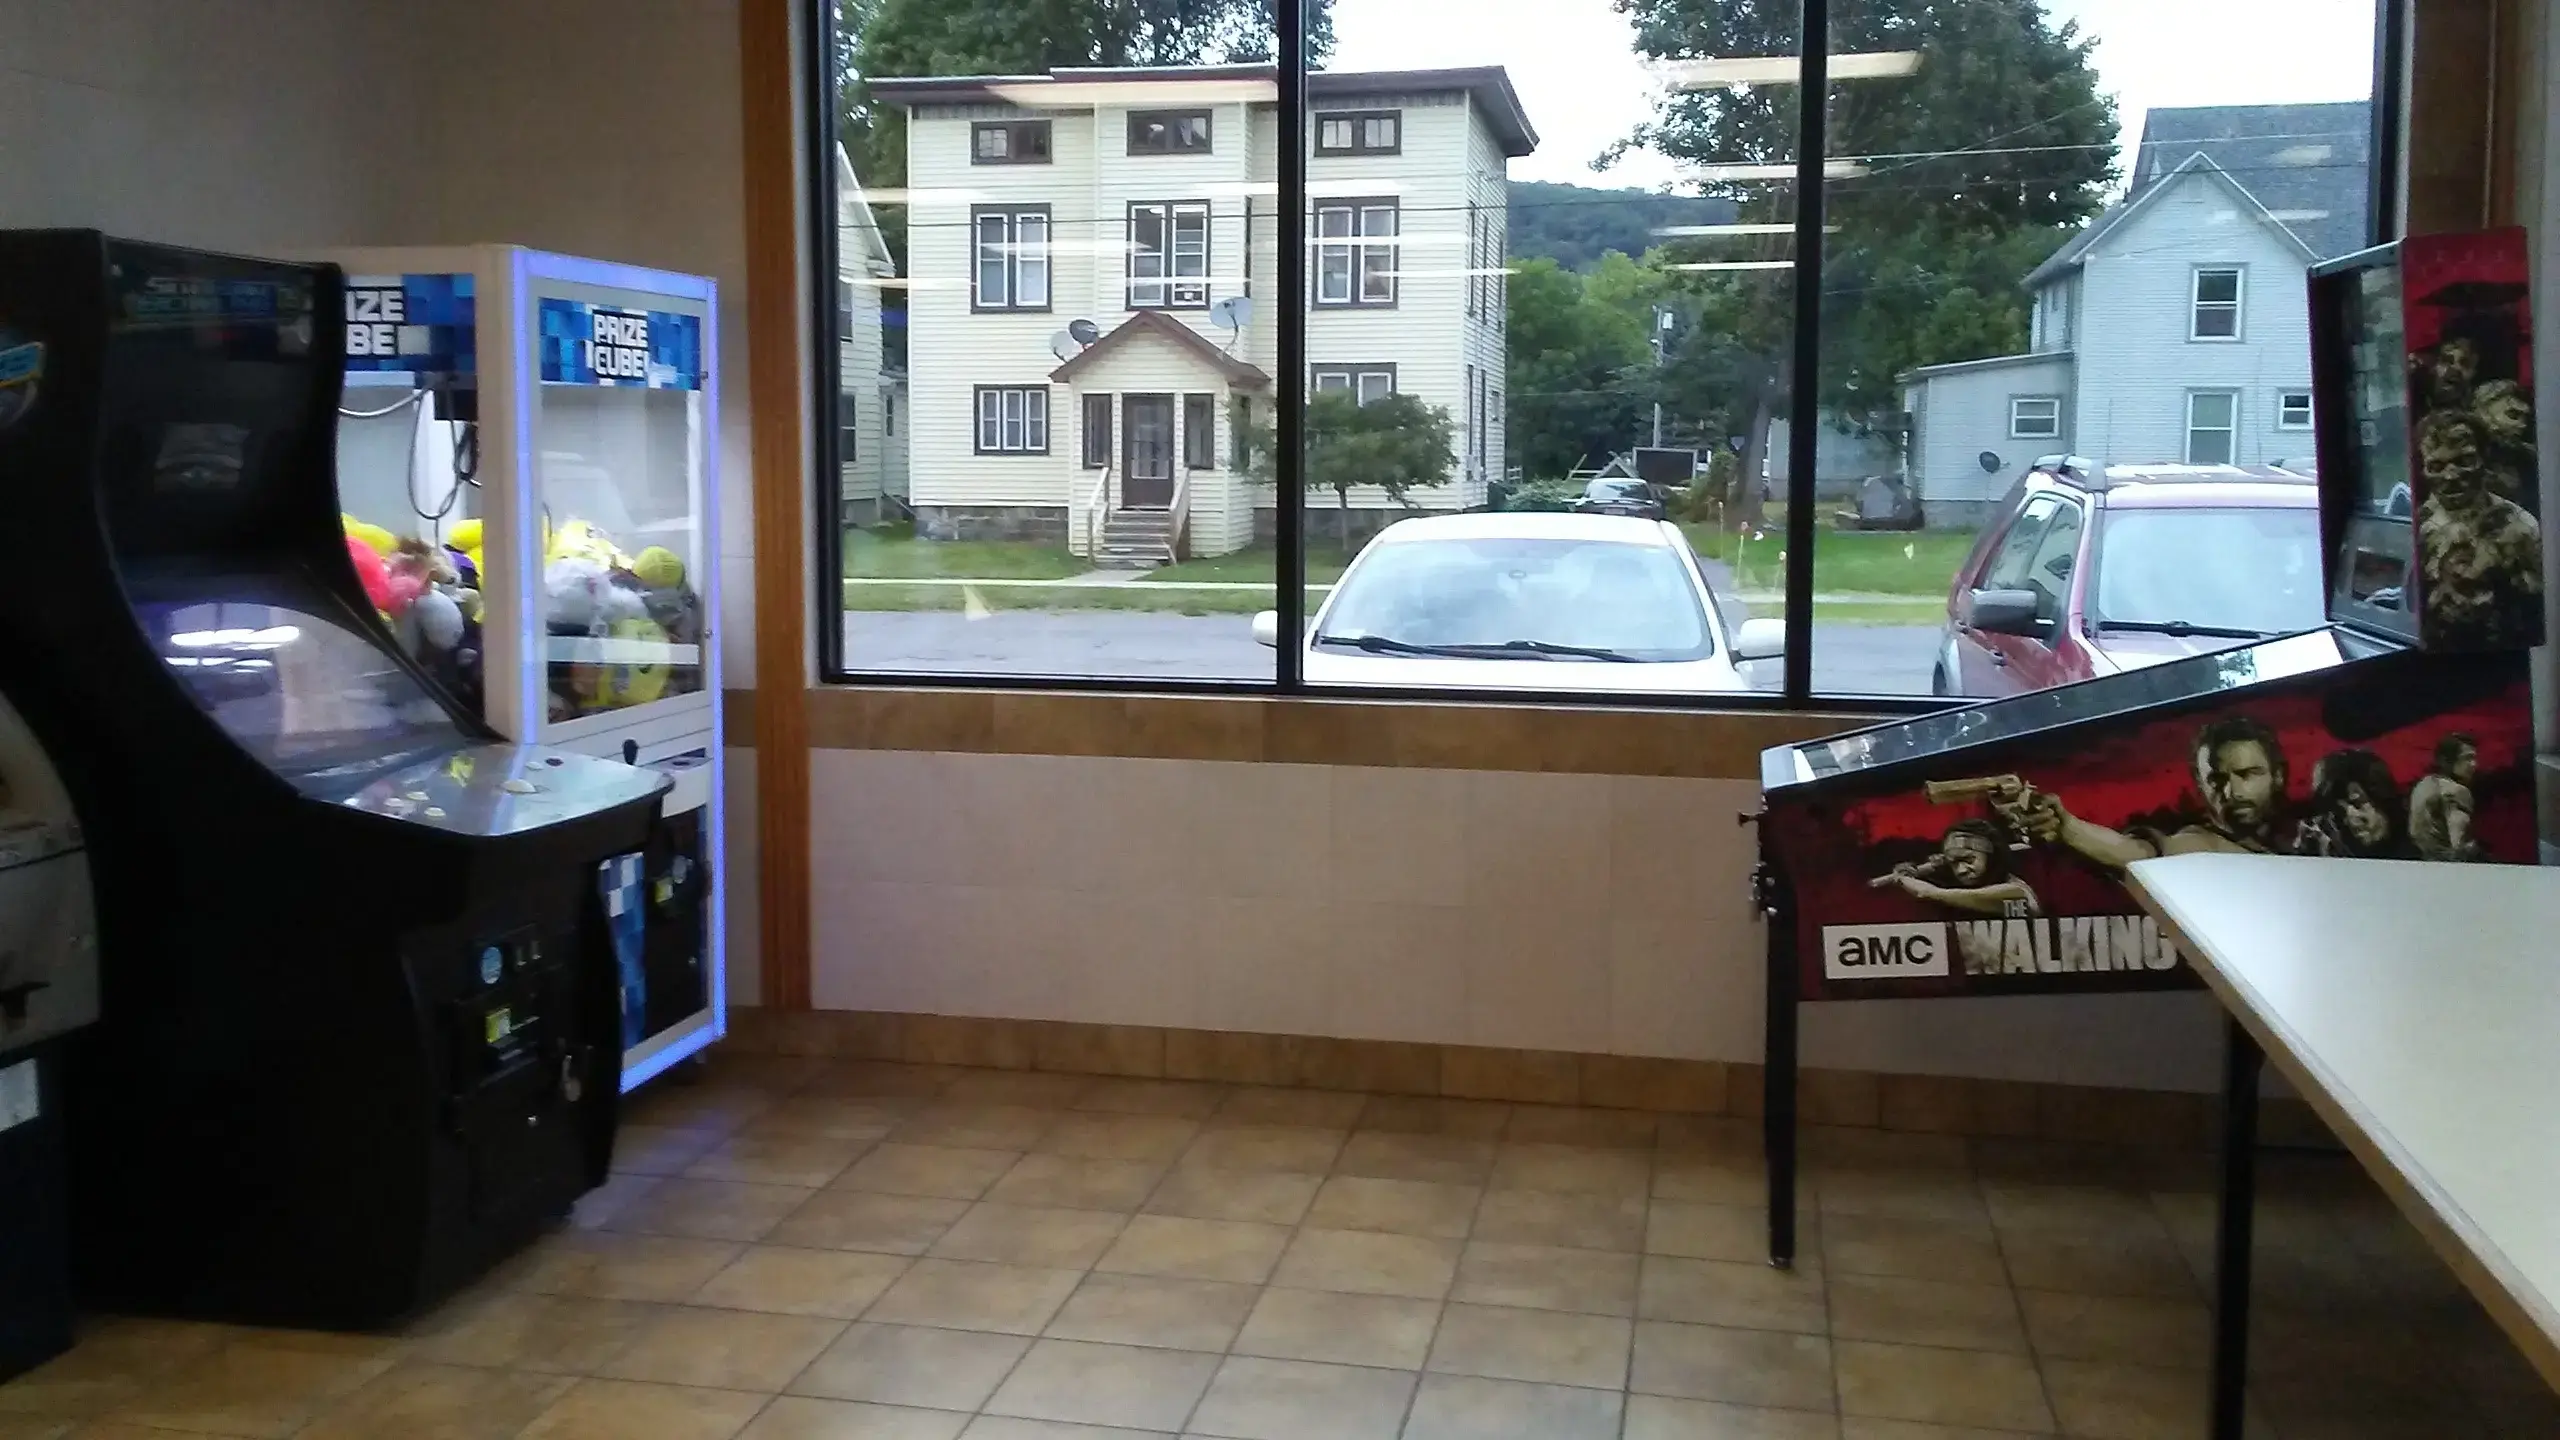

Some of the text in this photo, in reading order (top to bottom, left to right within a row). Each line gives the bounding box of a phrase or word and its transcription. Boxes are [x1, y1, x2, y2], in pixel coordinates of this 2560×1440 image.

[345, 290, 405, 322] IZE
[345, 323, 396, 356] BE
[593, 313, 649, 348] PRIZE
[594, 345, 645, 379] CUBE
[2003, 899, 2028, 917] THE
[1954, 914, 2179, 976] WALKING
